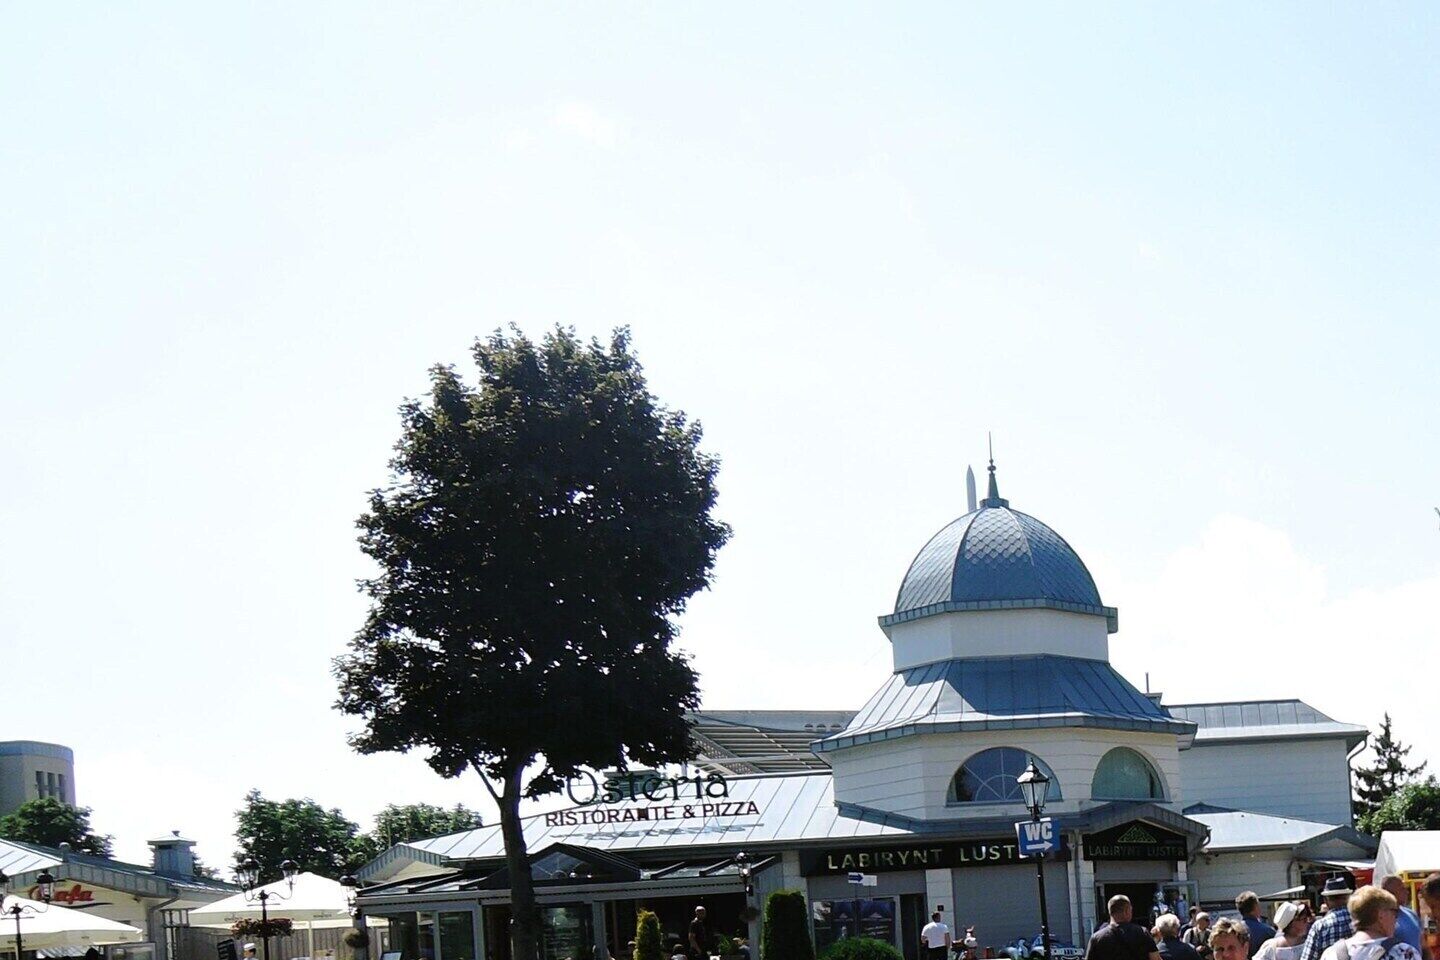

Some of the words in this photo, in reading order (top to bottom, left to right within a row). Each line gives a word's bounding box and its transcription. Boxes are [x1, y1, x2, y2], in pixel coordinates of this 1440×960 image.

[567, 769, 729, 805] Osteria
[545, 804, 676, 827] RISTORANTE
[683, 805, 695, 819] &
[703, 801, 760, 818] PIZZA
[1025, 821, 1053, 841] WC
[828, 849, 942, 870] LABIRYNT
